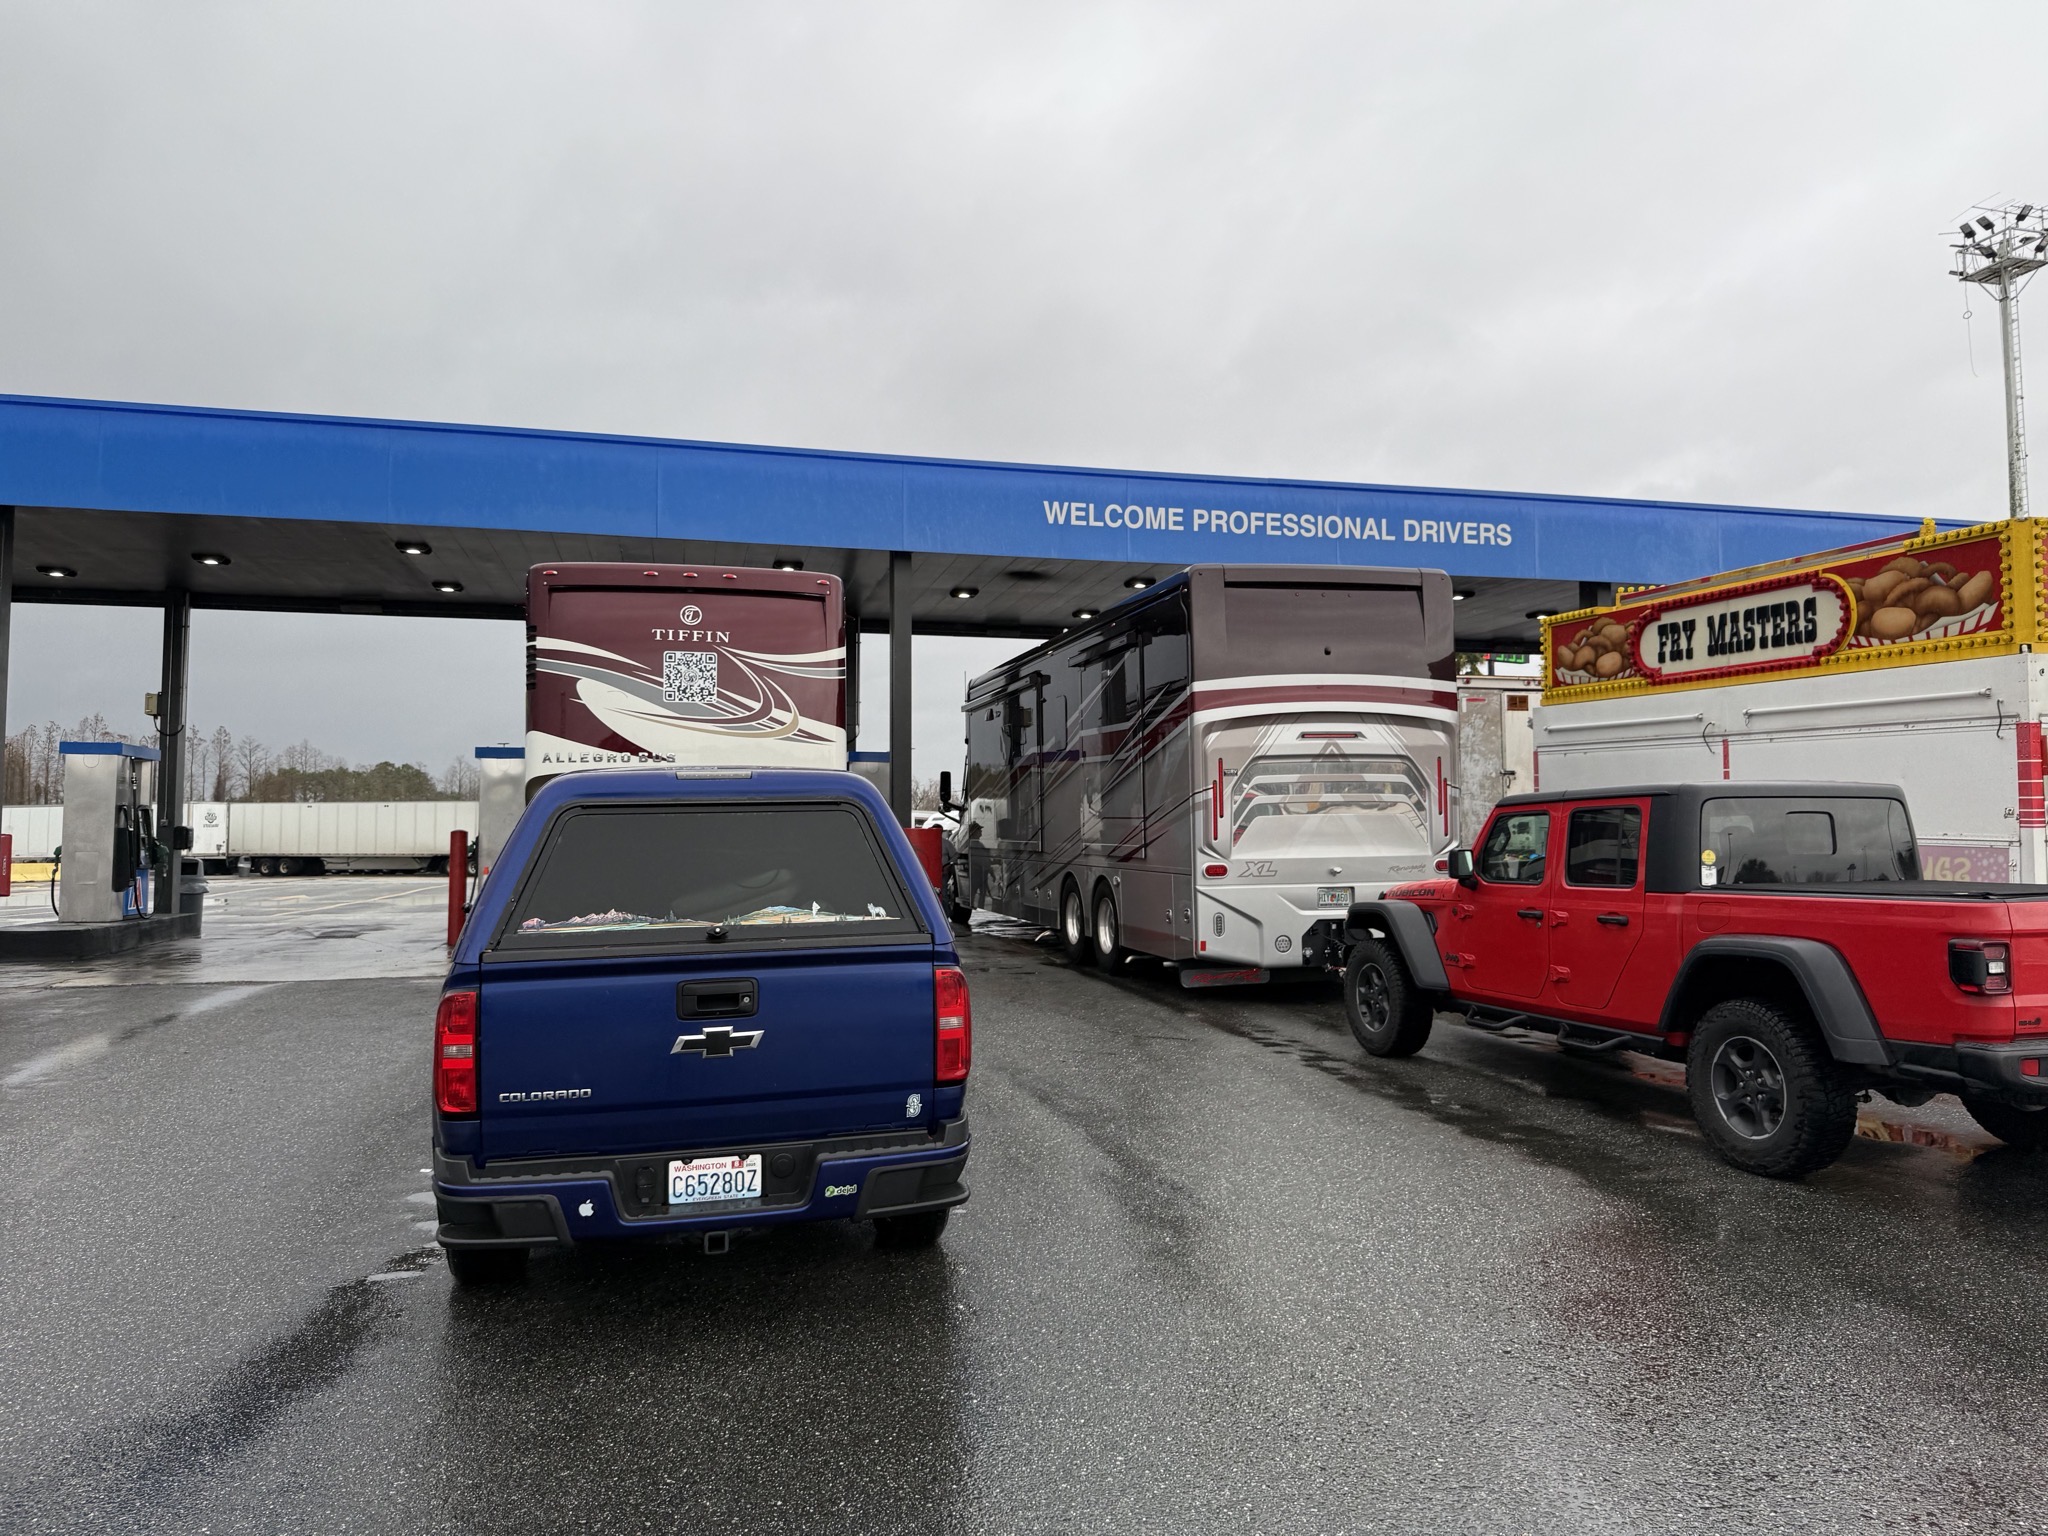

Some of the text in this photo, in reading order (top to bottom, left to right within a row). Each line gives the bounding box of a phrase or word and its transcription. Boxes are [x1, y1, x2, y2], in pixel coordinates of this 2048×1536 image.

[1043, 500, 1513, 547] WELCOME PROFESSIONAL DRIVERS
[651, 628, 731, 644] TIFFIN
[1657, 596, 1818, 664] FRY MASTERS
[541, 751, 677, 764] ALLEGRO BUS
[1237, 860, 1278, 878] XL
[1388, 888, 1436, 897] RUBICON
[498, 1088, 592, 1103] COLORADO
[673, 1162, 727, 1172] WASHINGTON
[672, 1169, 757, 1198] C65280Z
